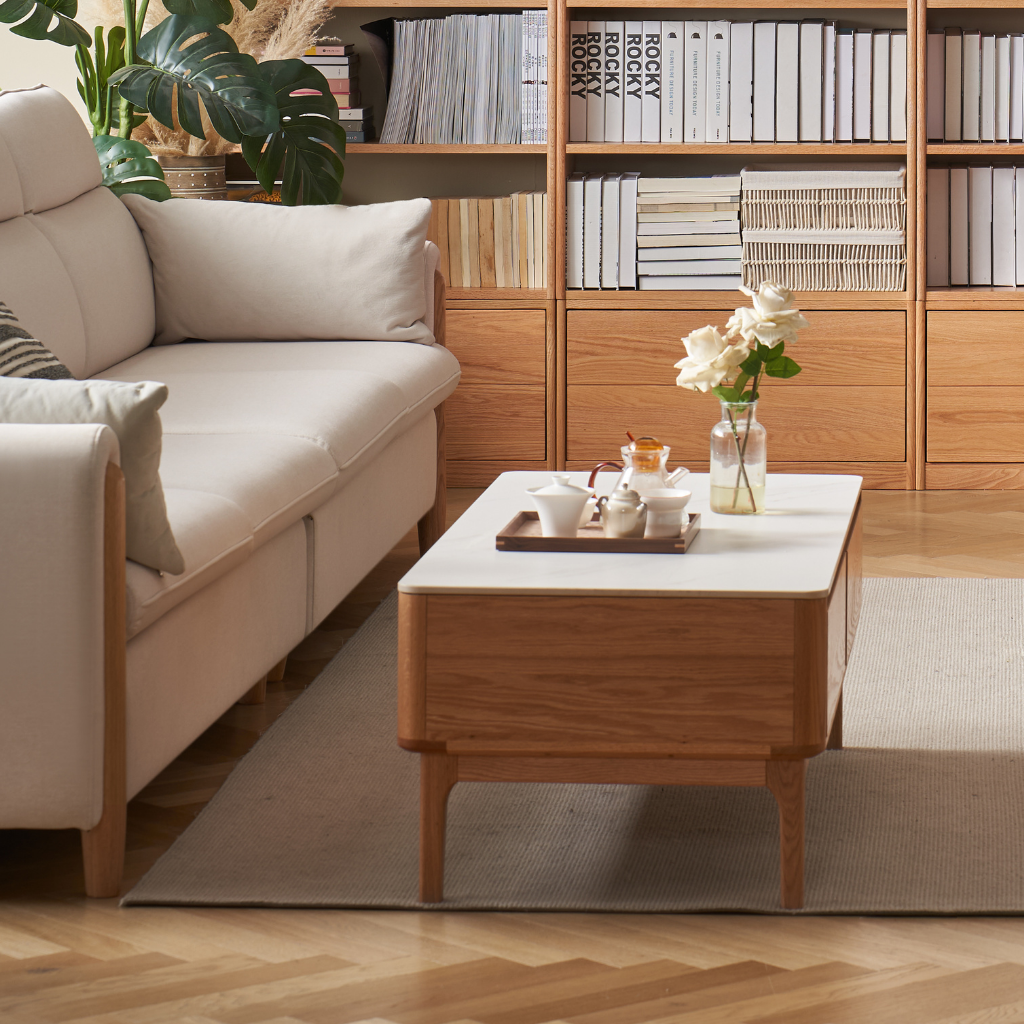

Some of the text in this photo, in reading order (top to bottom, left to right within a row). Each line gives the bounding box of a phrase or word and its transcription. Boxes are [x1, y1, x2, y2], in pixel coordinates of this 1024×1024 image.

[572, 34, 586, 99] ROCKY
[587, 32, 601, 98] ROCKY
[605, 33, 619, 98] ROCKY
[627, 34, 641, 99] ROCKY
[645, 34, 660, 99] ROCKY
